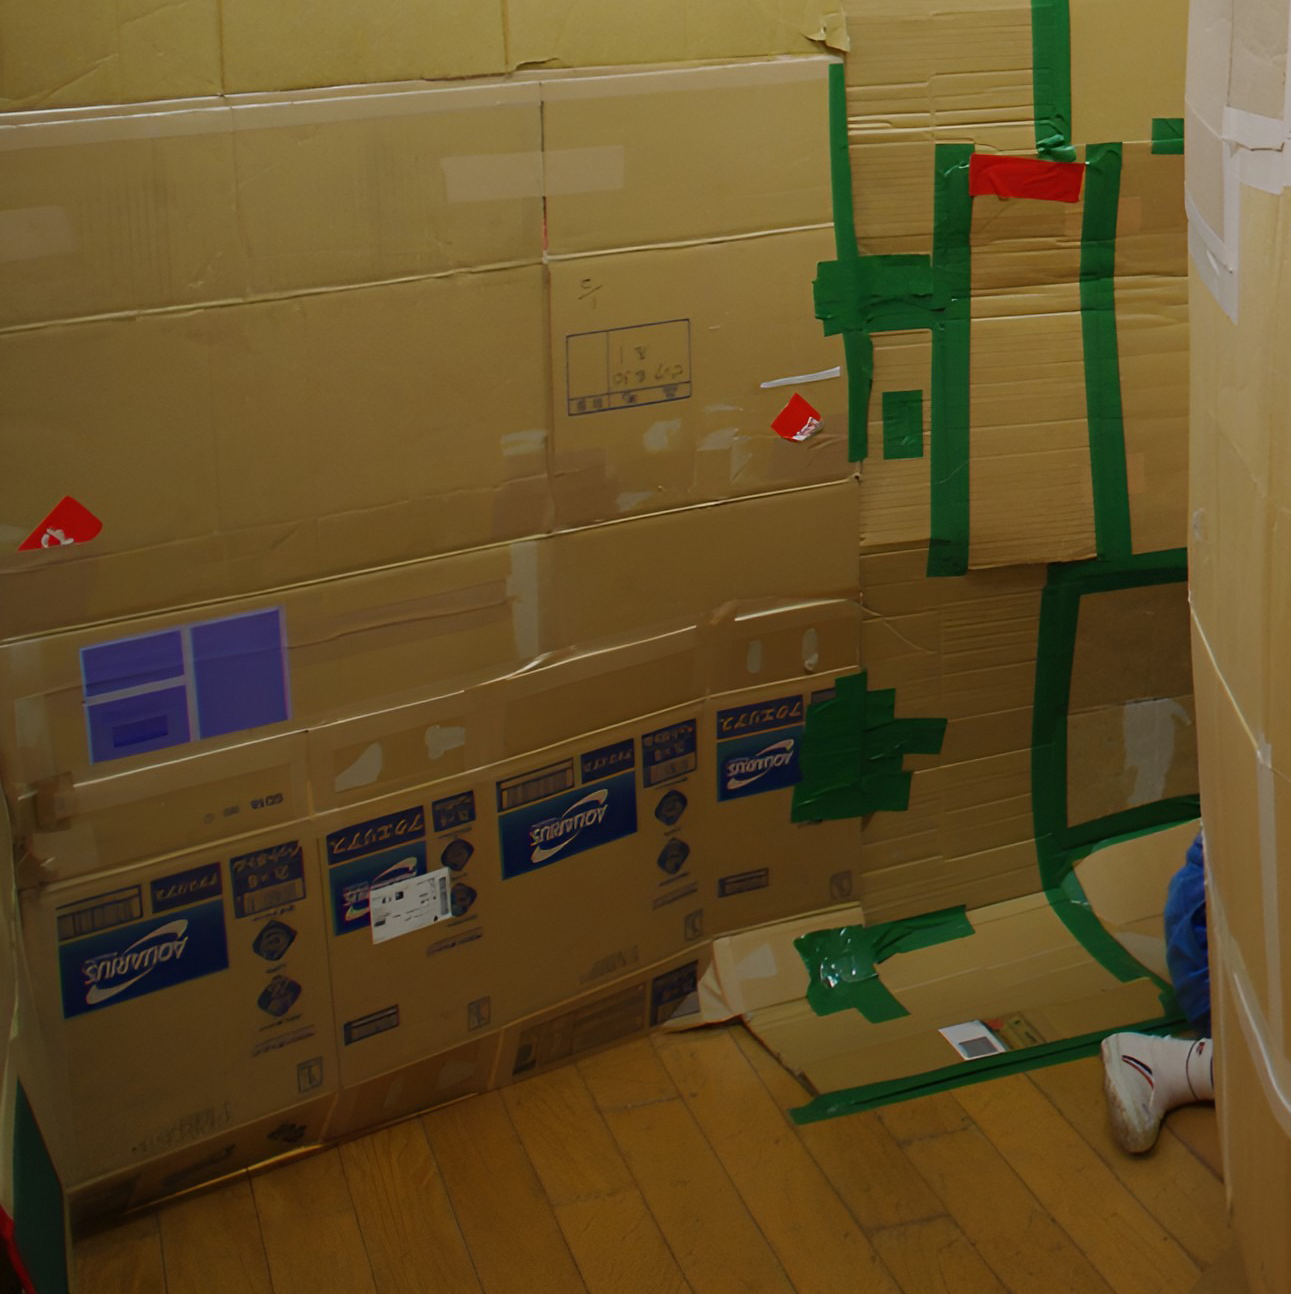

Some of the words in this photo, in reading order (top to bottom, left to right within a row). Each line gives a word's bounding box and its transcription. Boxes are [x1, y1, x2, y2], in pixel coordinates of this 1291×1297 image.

[720, 702, 801, 732] アクエリアス
[727, 750, 794, 777] AQUARIUS
[331, 813, 423, 854] アクエリアス
[530, 804, 608, 847] AQUARIUS
[84, 936, 189, 985] AQUARIUS
